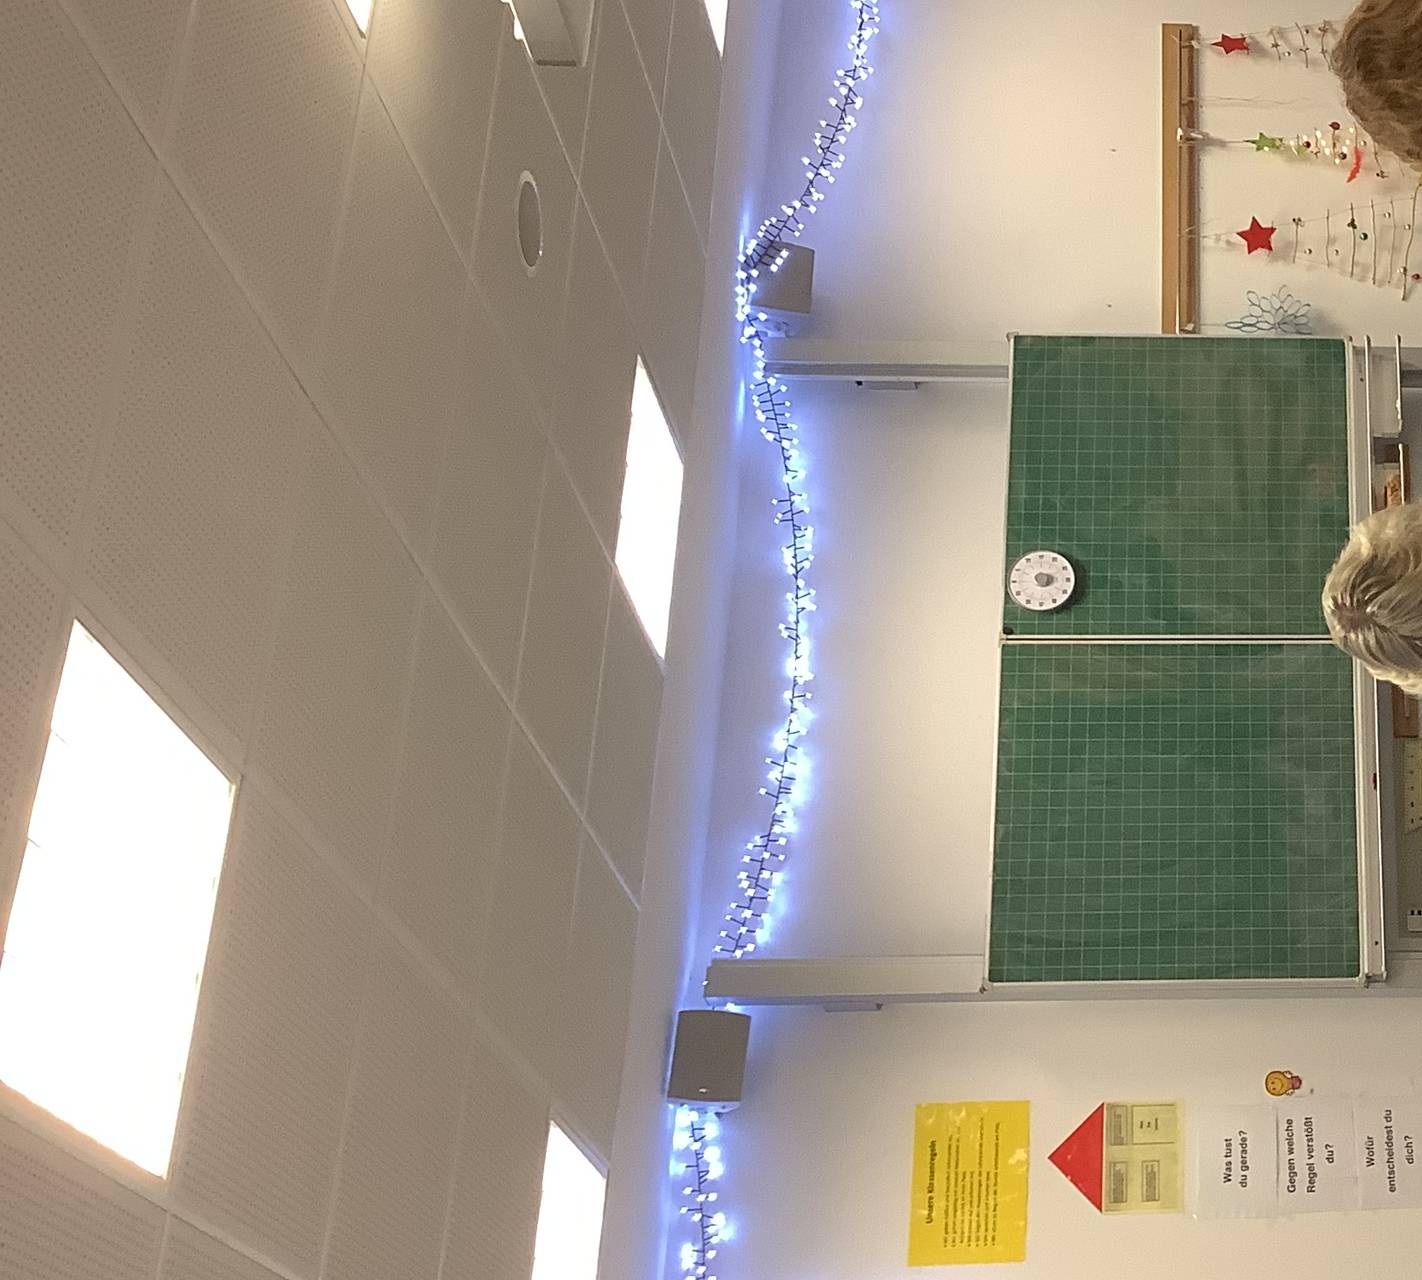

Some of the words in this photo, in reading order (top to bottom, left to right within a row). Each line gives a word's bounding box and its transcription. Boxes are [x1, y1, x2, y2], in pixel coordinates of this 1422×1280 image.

[1384, 1109, 1392, 1123] du
[1224, 1138, 1232, 1158] tust
[1238, 1130, 1249, 1172] gerade?
[1285, 1119, 1294, 1156] welche
[1304, 1117, 1314, 1160] verstößt
[1365, 1136, 1375, 1168] Wofür
[1404, 1135, 1414, 1164] dich?
[926, 1140, 937, 1194] Klassenregeln
[1324, 1144, 1334, 1164] du?
[1384, 1126, 1396, 1193] entscheidest
[1223, 1161, 1232, 1184] Was
[1238, 1174, 1247, 1188] du
[1287, 1158, 1297, 1193] Gegen
[1306, 1163, 1317, 1193] Regel
[926, 1195, 934, 1224] Unsere
